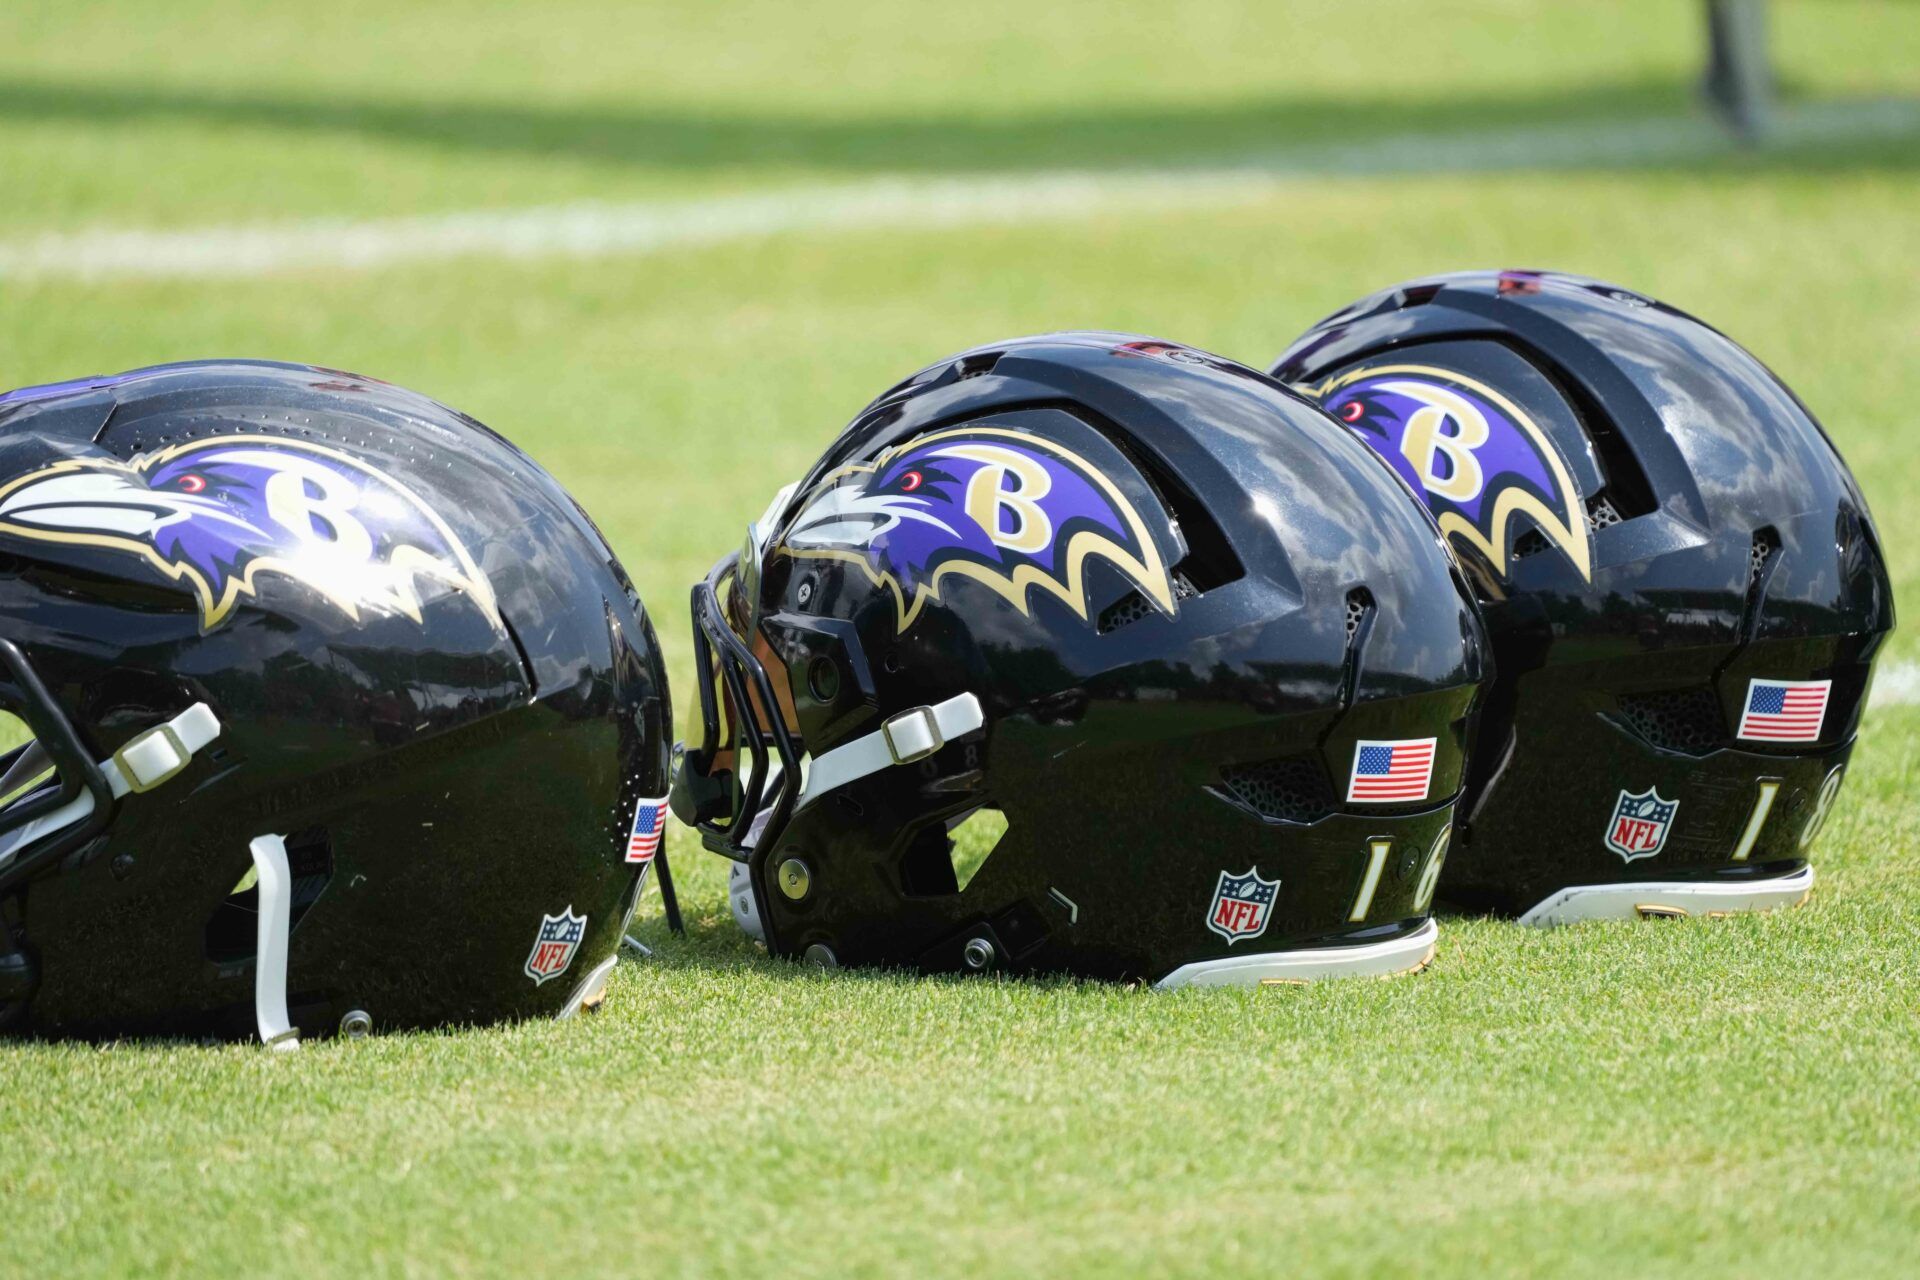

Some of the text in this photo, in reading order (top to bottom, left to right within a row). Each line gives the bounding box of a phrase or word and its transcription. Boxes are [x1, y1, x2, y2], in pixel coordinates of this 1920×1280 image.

[1370, 381, 1489, 502] B
[230, 451, 374, 562] B
[925, 444, 1052, 554] B
[1612, 817, 1658, 850] NFL
[1215, 898, 1262, 932] NFL
[532, 943, 570, 973] NFL
